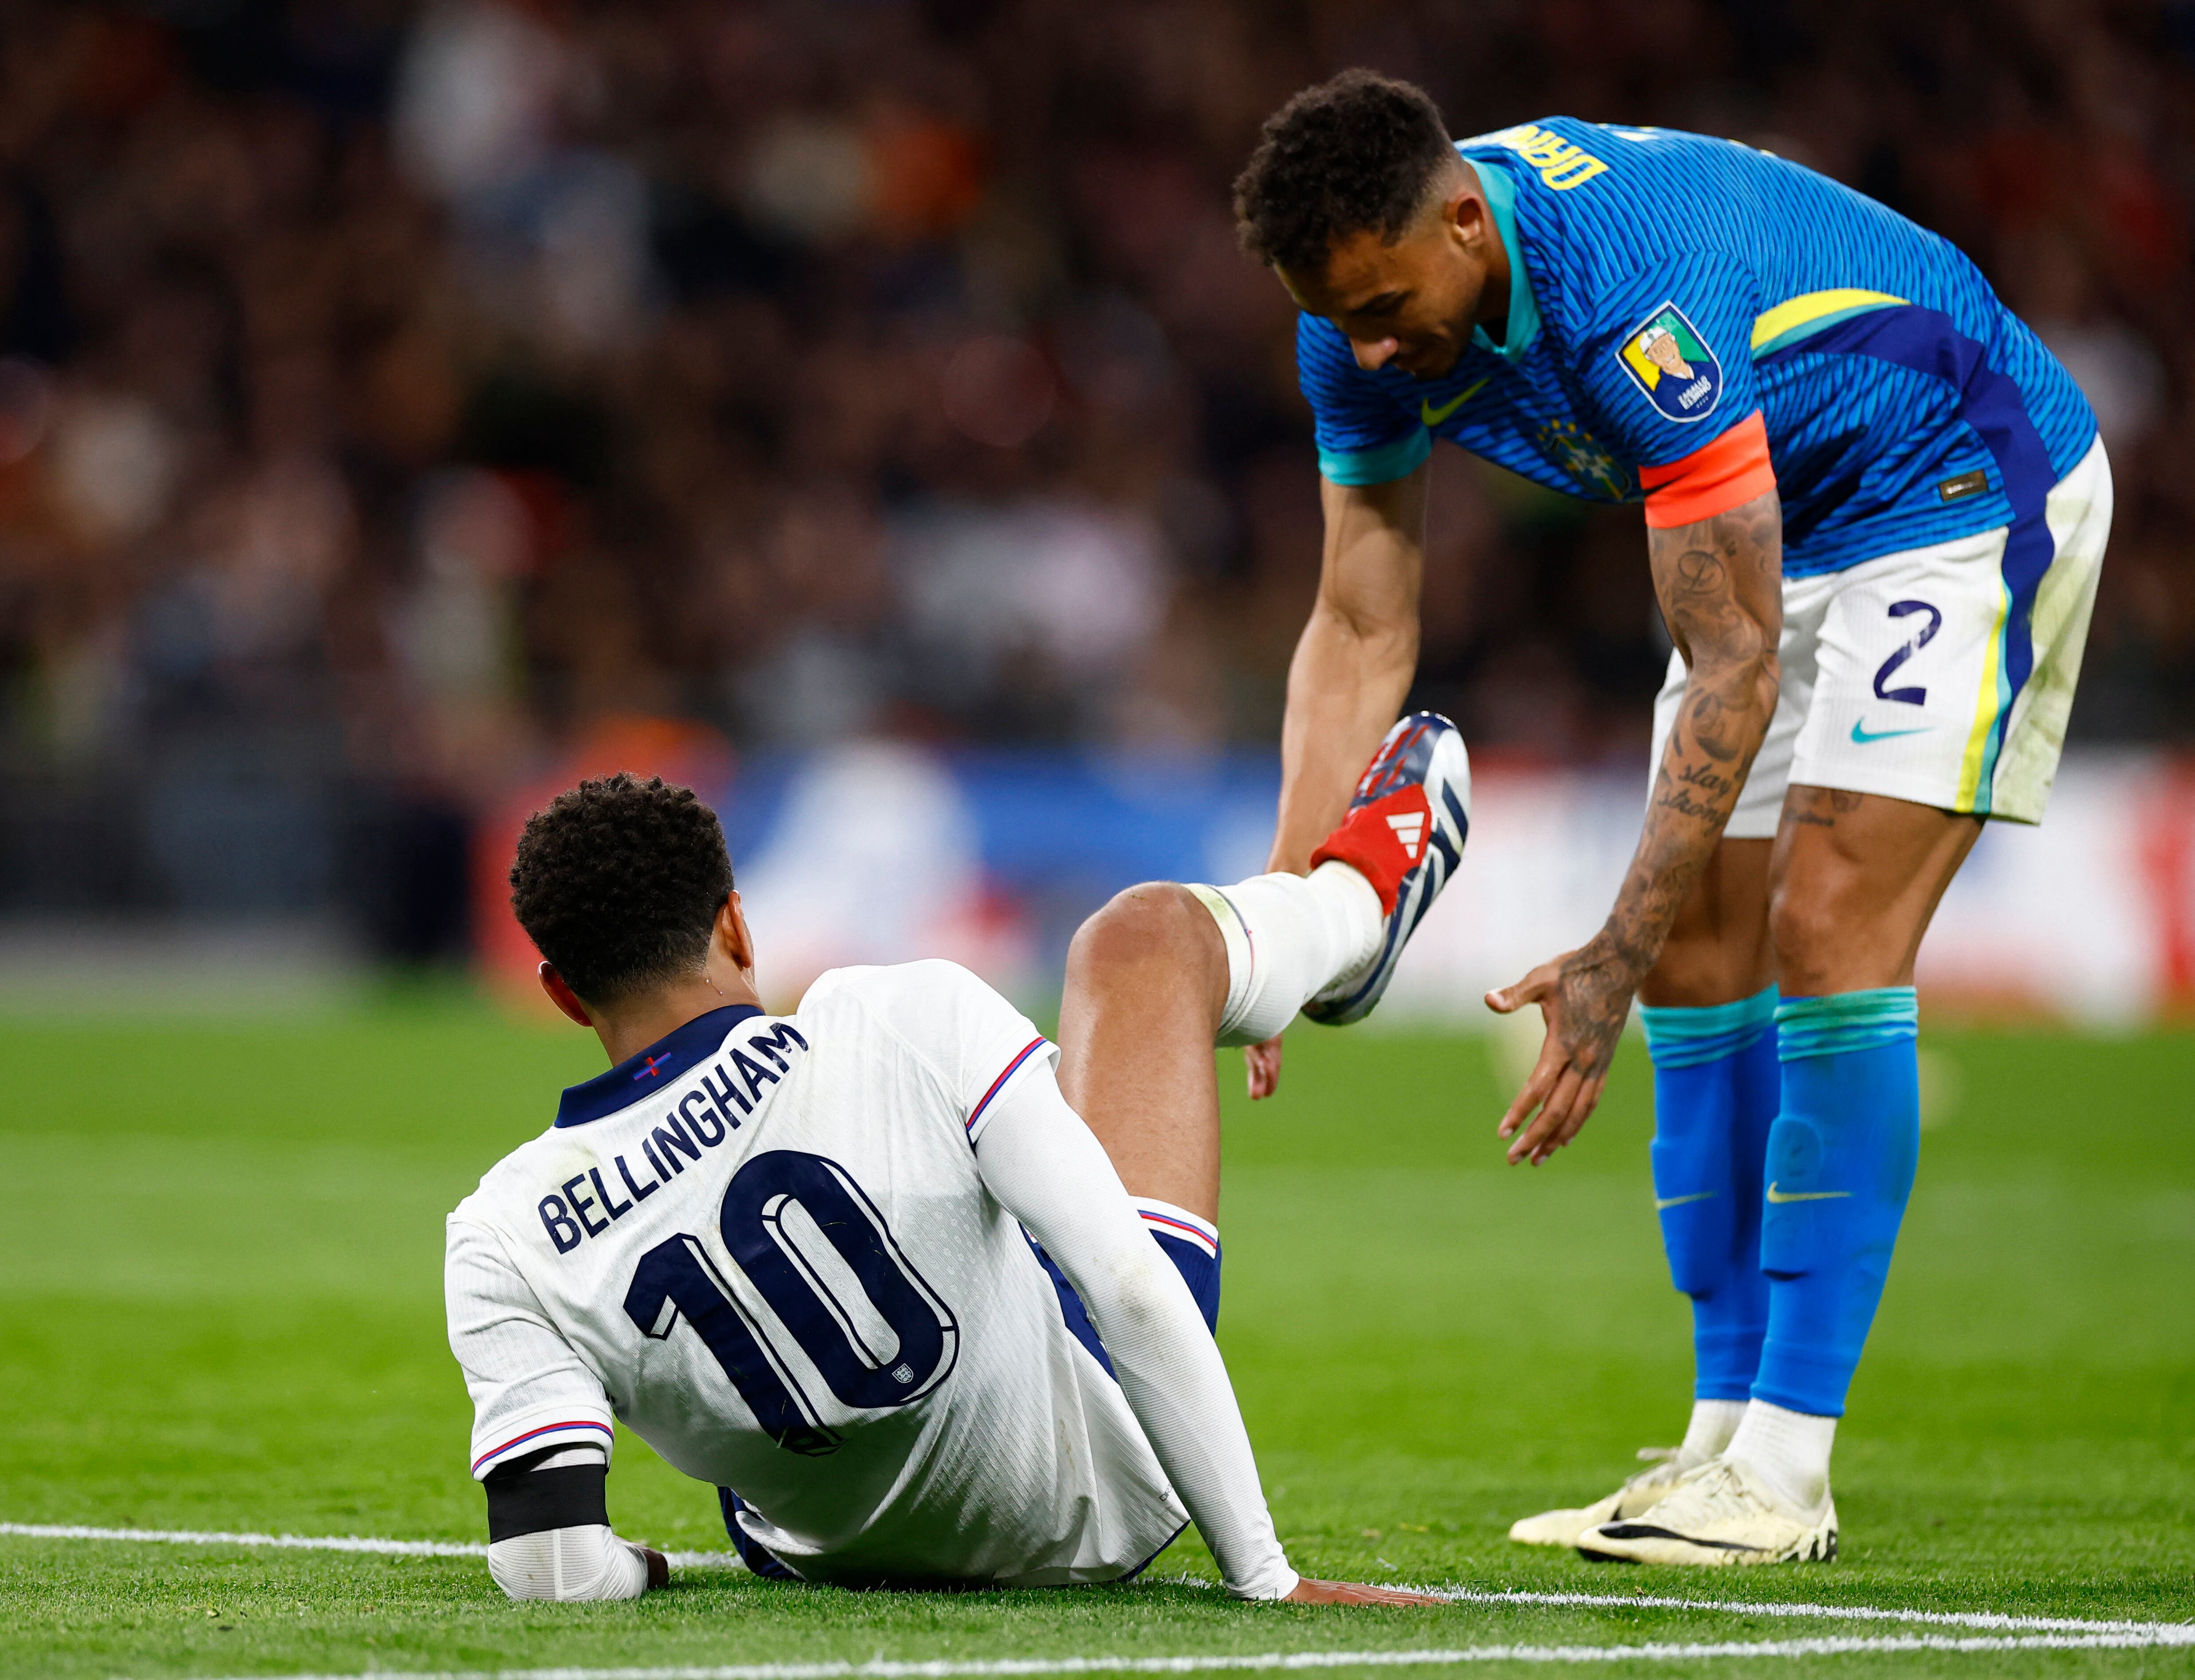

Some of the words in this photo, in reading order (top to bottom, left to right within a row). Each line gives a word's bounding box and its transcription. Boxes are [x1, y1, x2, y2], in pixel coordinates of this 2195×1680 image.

[1873, 600, 1942, 706] 2
[538, 1022, 808, 1255] BELLINGHAM
[623, 1150, 960, 1456] 10
